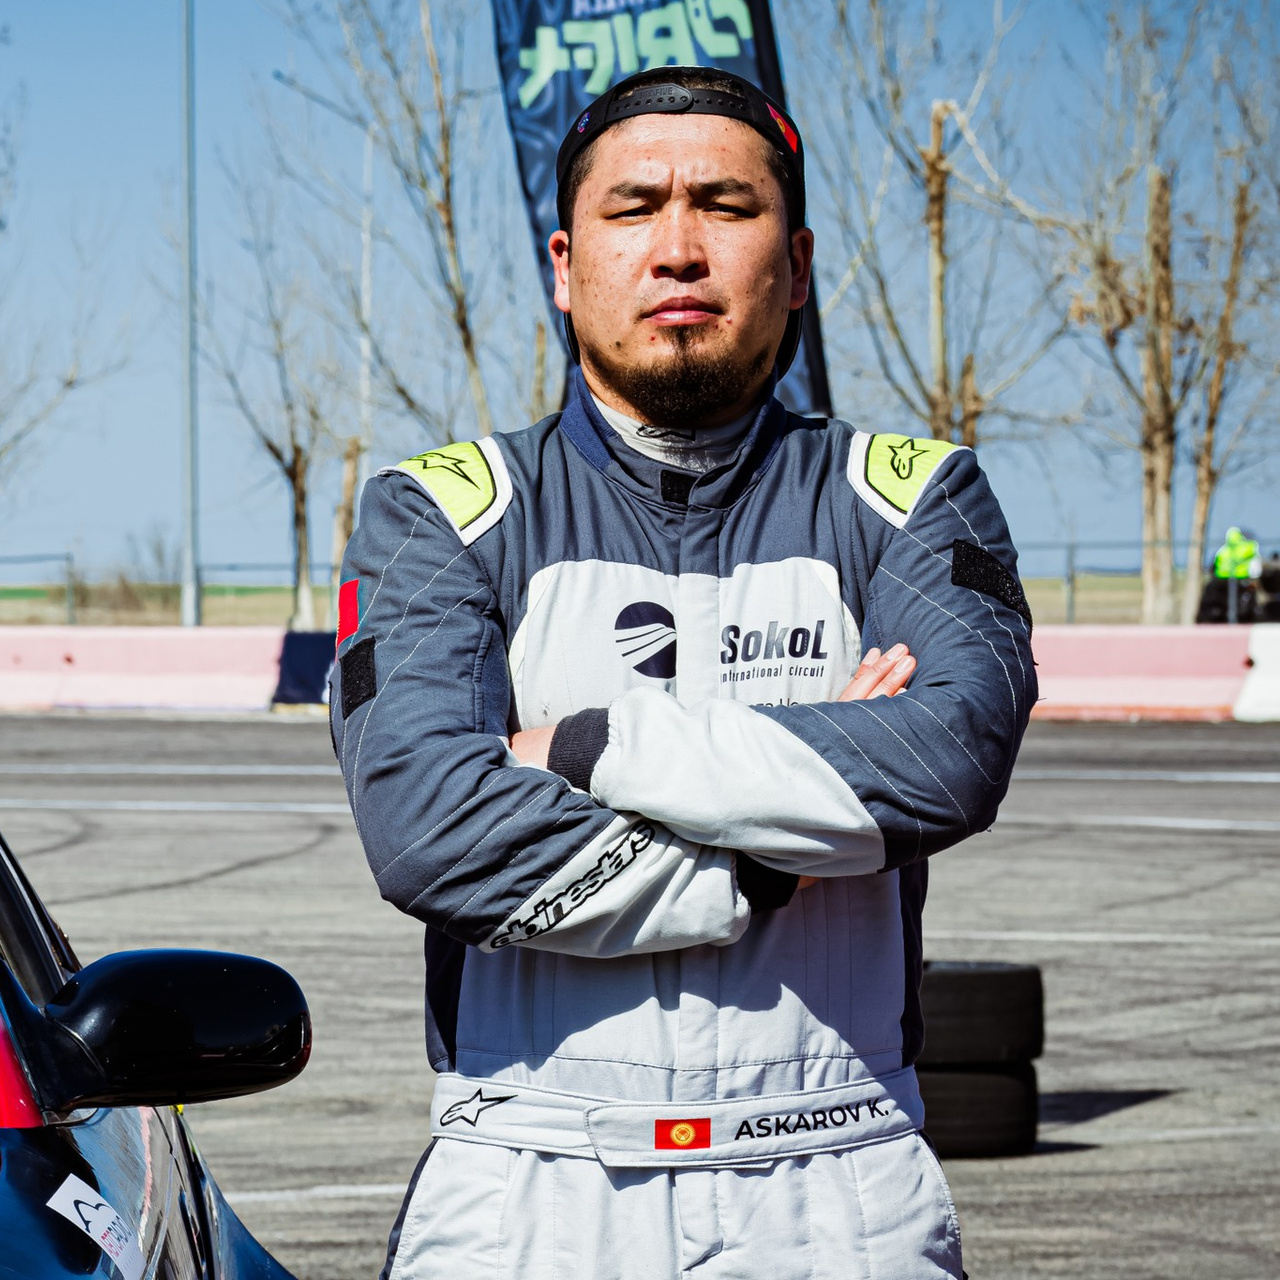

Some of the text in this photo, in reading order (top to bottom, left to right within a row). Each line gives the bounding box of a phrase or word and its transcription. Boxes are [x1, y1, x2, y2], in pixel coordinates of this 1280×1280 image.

[788, 664, 825, 678] circuit
[734, 1097, 889, 1141] ASKAROV K.
